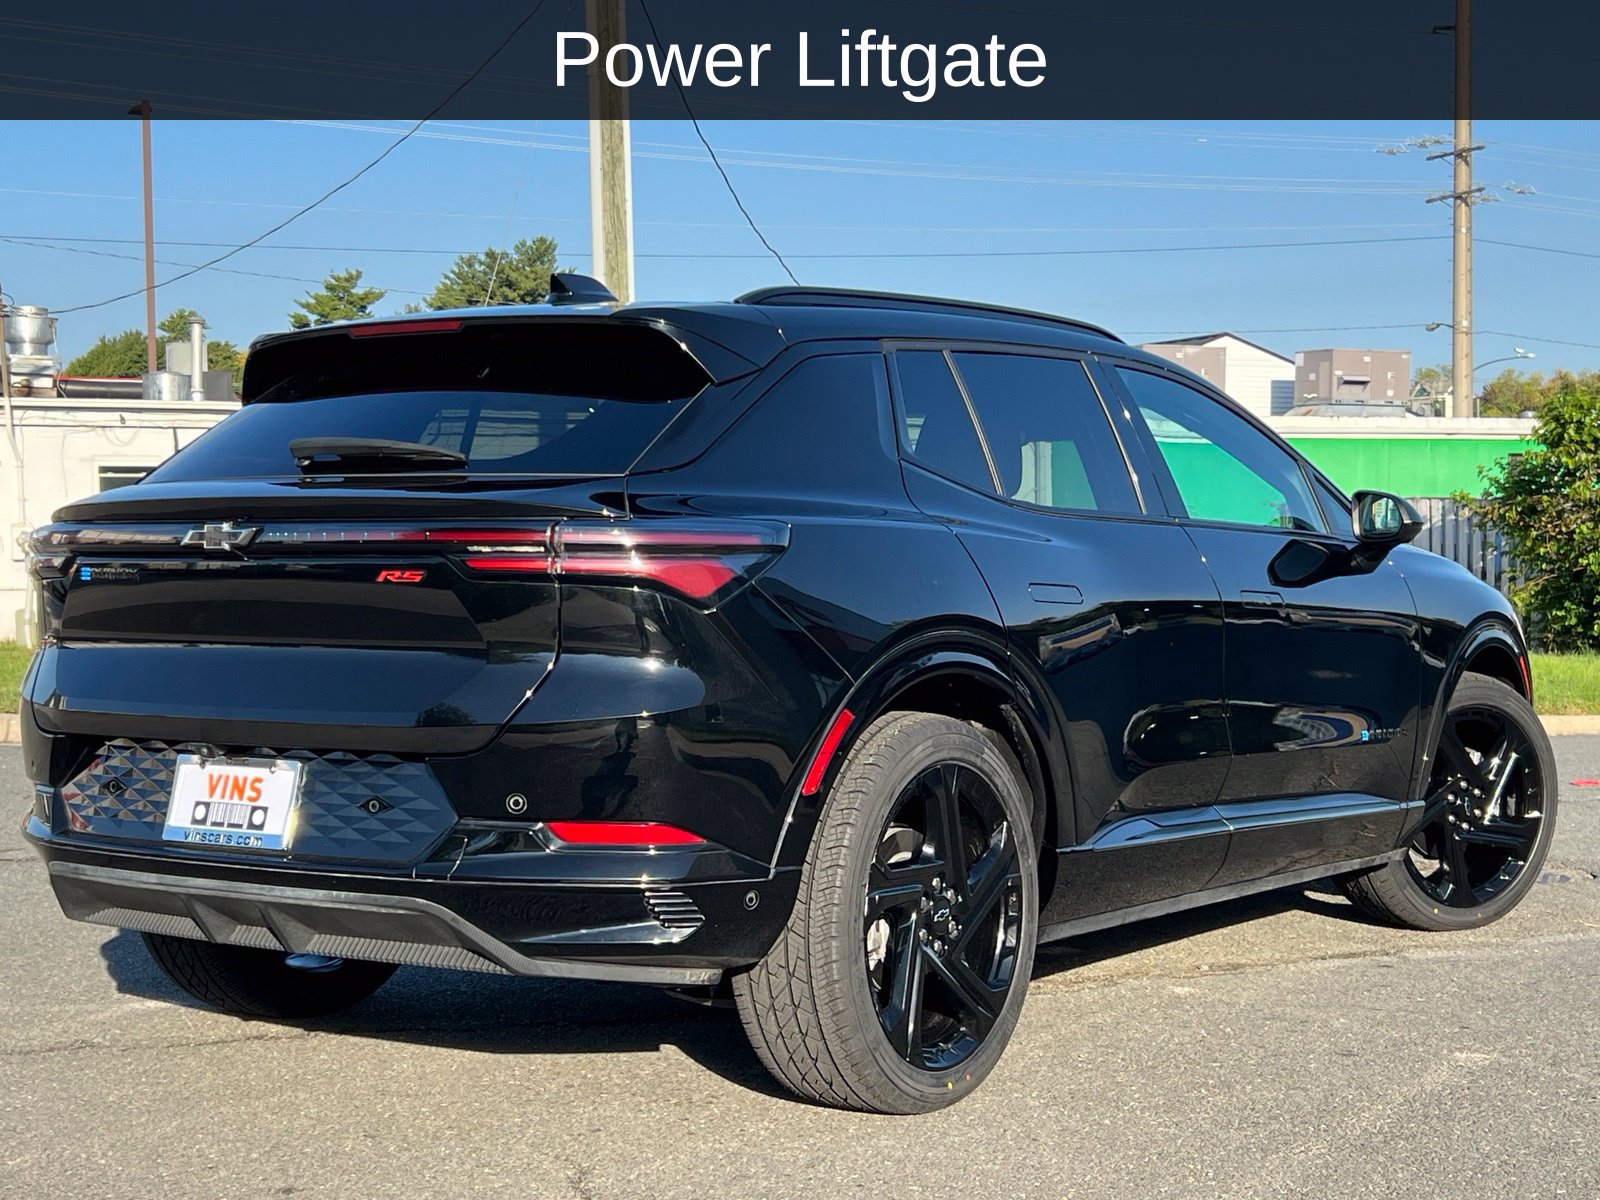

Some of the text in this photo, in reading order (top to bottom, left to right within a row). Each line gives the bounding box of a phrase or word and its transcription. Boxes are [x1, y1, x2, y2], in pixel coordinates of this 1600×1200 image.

[376, 569, 425, 583] RS
[207, 773, 264, 803] VINS
[184, 828, 264, 847] vinscars.com
